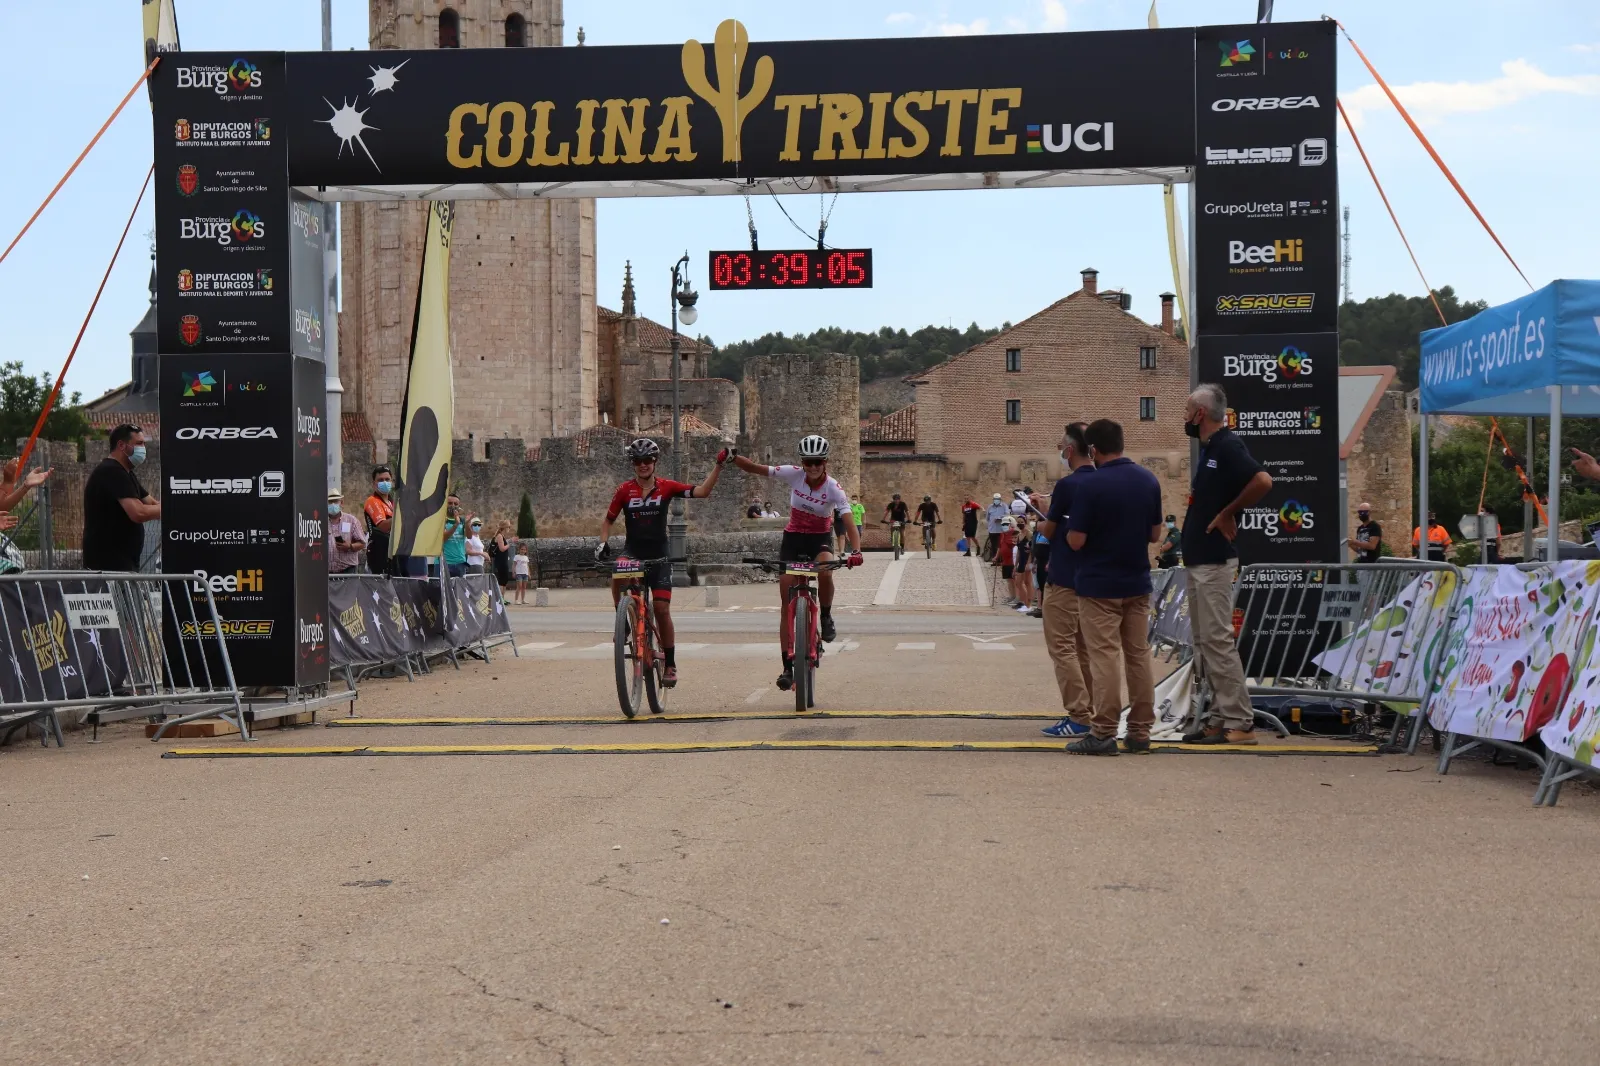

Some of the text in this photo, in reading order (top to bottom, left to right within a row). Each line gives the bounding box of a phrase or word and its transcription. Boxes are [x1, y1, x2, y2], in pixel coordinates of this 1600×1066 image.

[177, 58, 262, 94] Burgos
[1211, 96, 1321, 112] ORBEA
[193, 122, 251, 131] DIPUTACION
[445, 95, 697, 168] COLINA
[774, 87, 1022, 162] TRISTE
[193, 131, 252, 139] DE BURGOS
[1043, 121, 1114, 153] UCI
[220, 185, 246, 193] Domingo
[1204, 202, 1284, 216] GrupoUreta
[180, 209, 265, 245] Burgos
[1229, 239, 1303, 264] BeeHi
[715, 252, 865, 285] 03:39:05
[196, 273, 254, 281] DIPUTACION
[196, 281, 254, 289] DE BURGOS
[1217, 294, 1314, 311] X-SAUCE
[222, 335, 248, 343] Domingo
[1424, 311, 1546, 388] www.rs-sport.es
[1223, 345, 1313, 383] Burgos
[1239, 411, 1301, 420] DIPUTACION
[1239, 420, 1301, 429] DE BURGOS
[176, 427, 278, 440] ORBEA
[629, 495, 662, 507] BH
[1238, 500, 1314, 536] urgos
[169, 529, 245, 543] GrupoUreta
[193, 569, 263, 593] BeeHi
[80, 614, 109, 625] BURGOS
